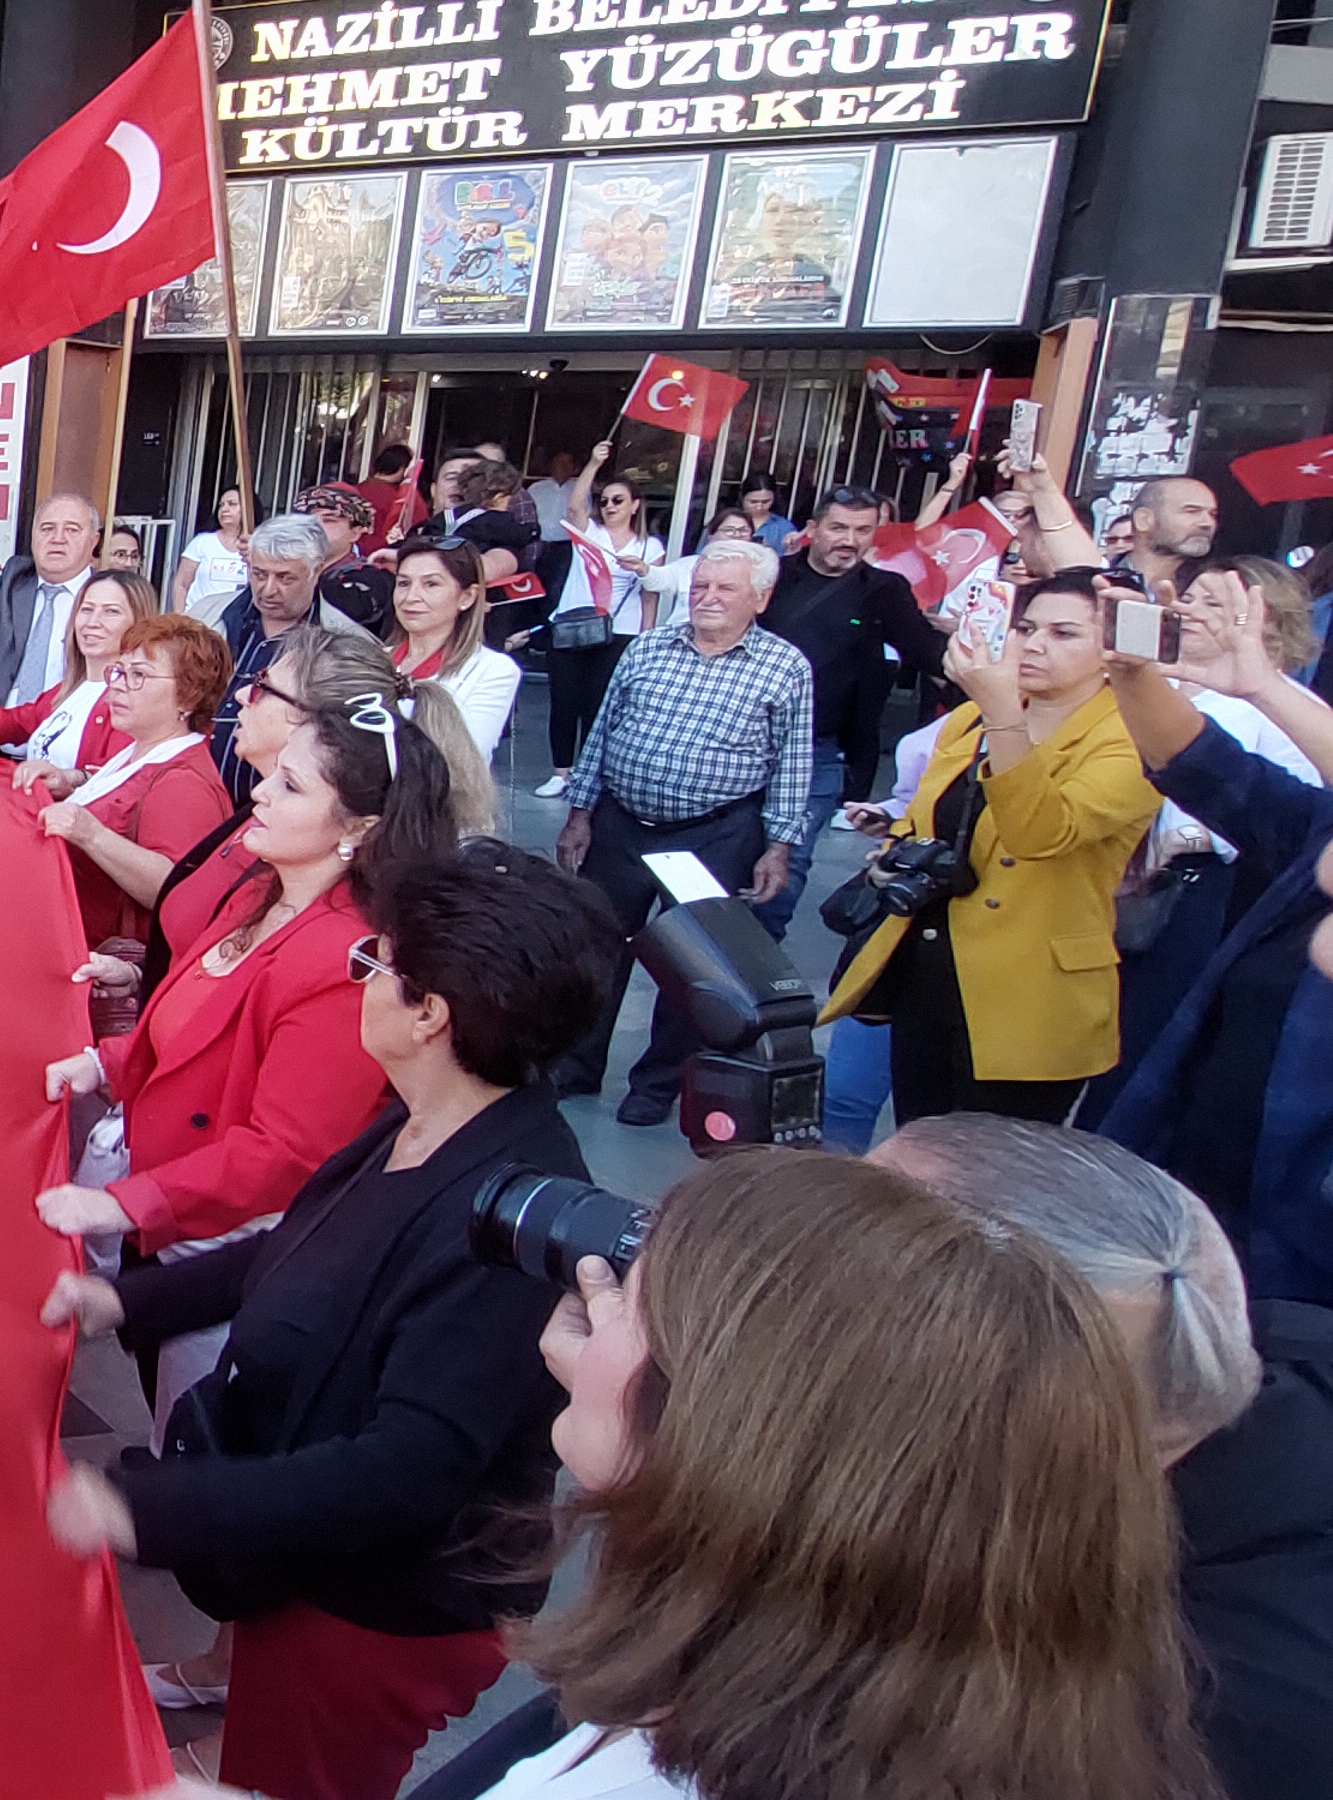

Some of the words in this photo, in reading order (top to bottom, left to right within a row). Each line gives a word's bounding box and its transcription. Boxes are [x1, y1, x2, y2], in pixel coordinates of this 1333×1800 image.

[559, 11, 1076, 92] YÜZÜGÜLER
[239, 106, 529, 164] KÜLTÜR
[561, 69, 966, 141] MERKEZİ
